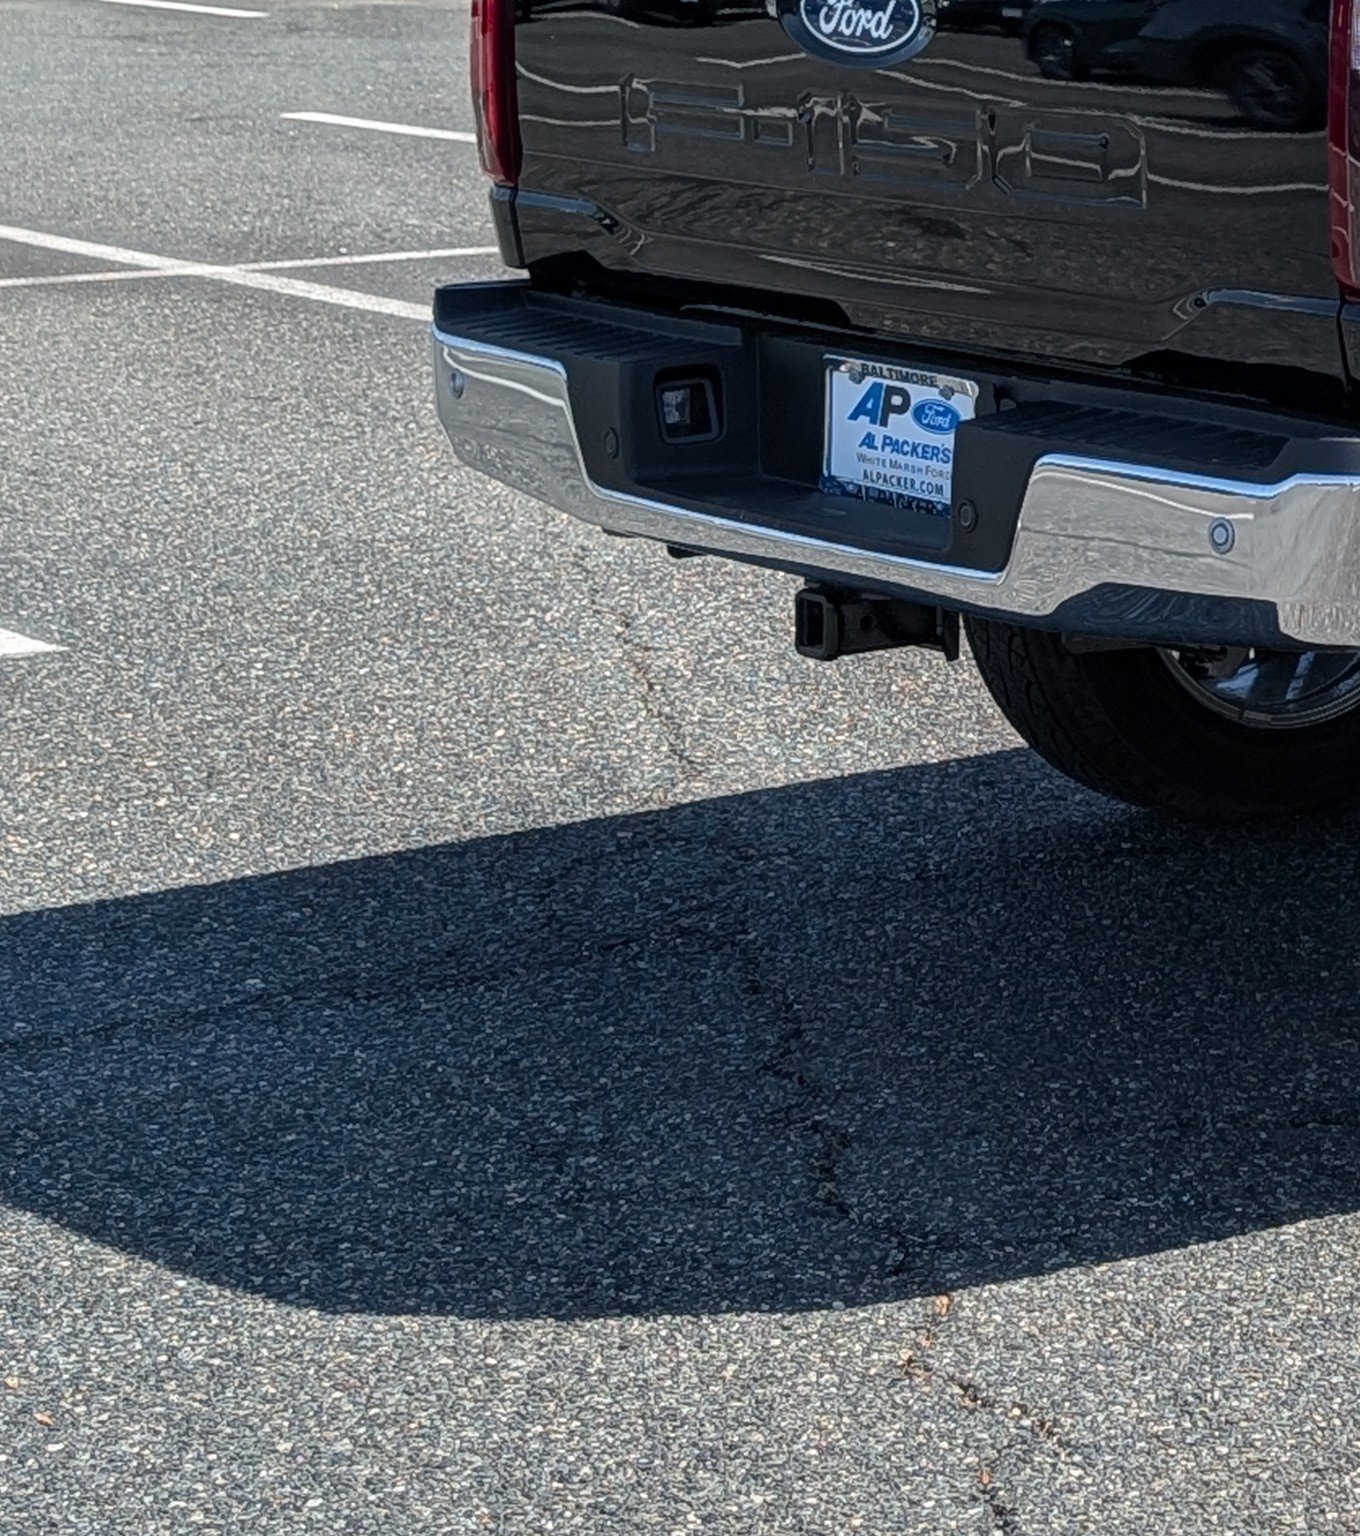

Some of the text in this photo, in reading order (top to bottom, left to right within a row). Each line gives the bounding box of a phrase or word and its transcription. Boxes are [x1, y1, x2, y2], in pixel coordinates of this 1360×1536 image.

[861, 363, 939, 388] BALTIMORE
[847, 381, 952, 429] AP Ford
[858, 431, 951, 464] AL PACKER'S
[863, 469, 944, 496] ALPACKER.COM
